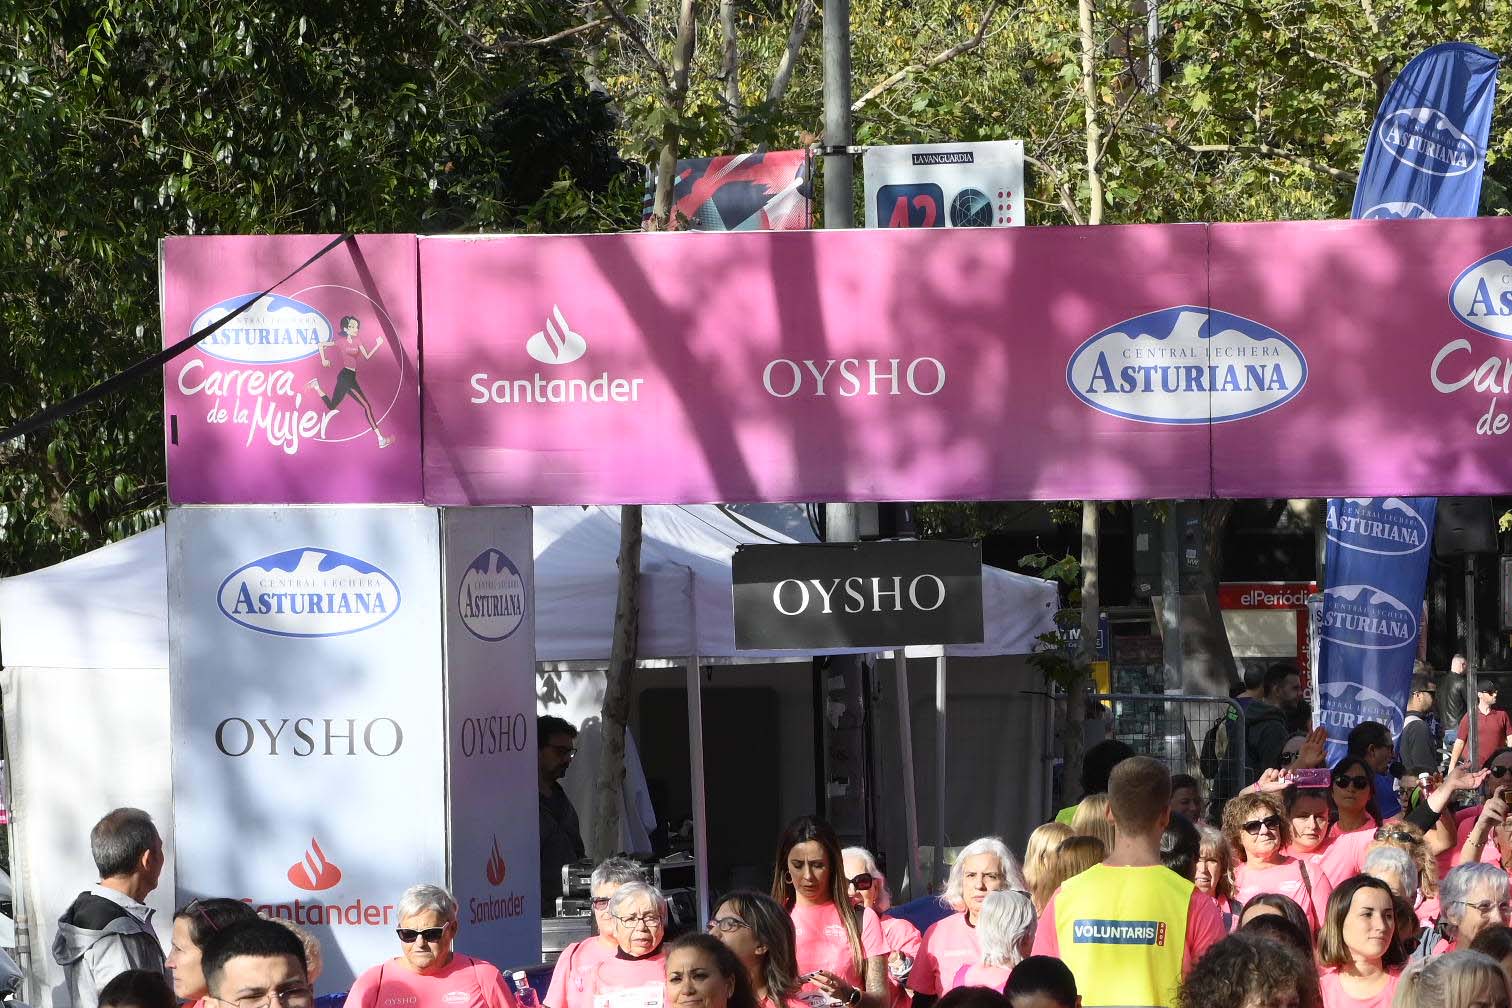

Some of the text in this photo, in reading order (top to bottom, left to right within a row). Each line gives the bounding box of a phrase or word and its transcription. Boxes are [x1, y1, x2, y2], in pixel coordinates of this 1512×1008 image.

[1385, 119, 1468, 168] ASTURIANA
[1121, 347, 1198, 359] CENTRAL
[178, 358, 296, 396] Carrera
[470, 371, 645, 404] Santander
[762, 356, 947, 399] OYSHO
[1085, 351, 1289, 396] ASTURIANA
[206, 393, 341, 455] de la Mujer
[1476, 397, 1510, 437] de
[1326, 505, 1420, 546] ASTURIANA
[231, 581, 387, 615] ASTURIANA
[464, 583, 522, 618] ASTURIANA
[772, 572, 946, 617] OYSHO
[1240, 589, 1312, 609] elPeriódi
[214, 717, 404, 757] OYSHO
[460, 713, 528, 759] OYSHO
[240, 898, 394, 926] antander
[469, 893, 525, 925] Santander
[1074, 924, 1155, 940] VOLUNTARIS
[384, 995, 418, 1006] OYSHO
